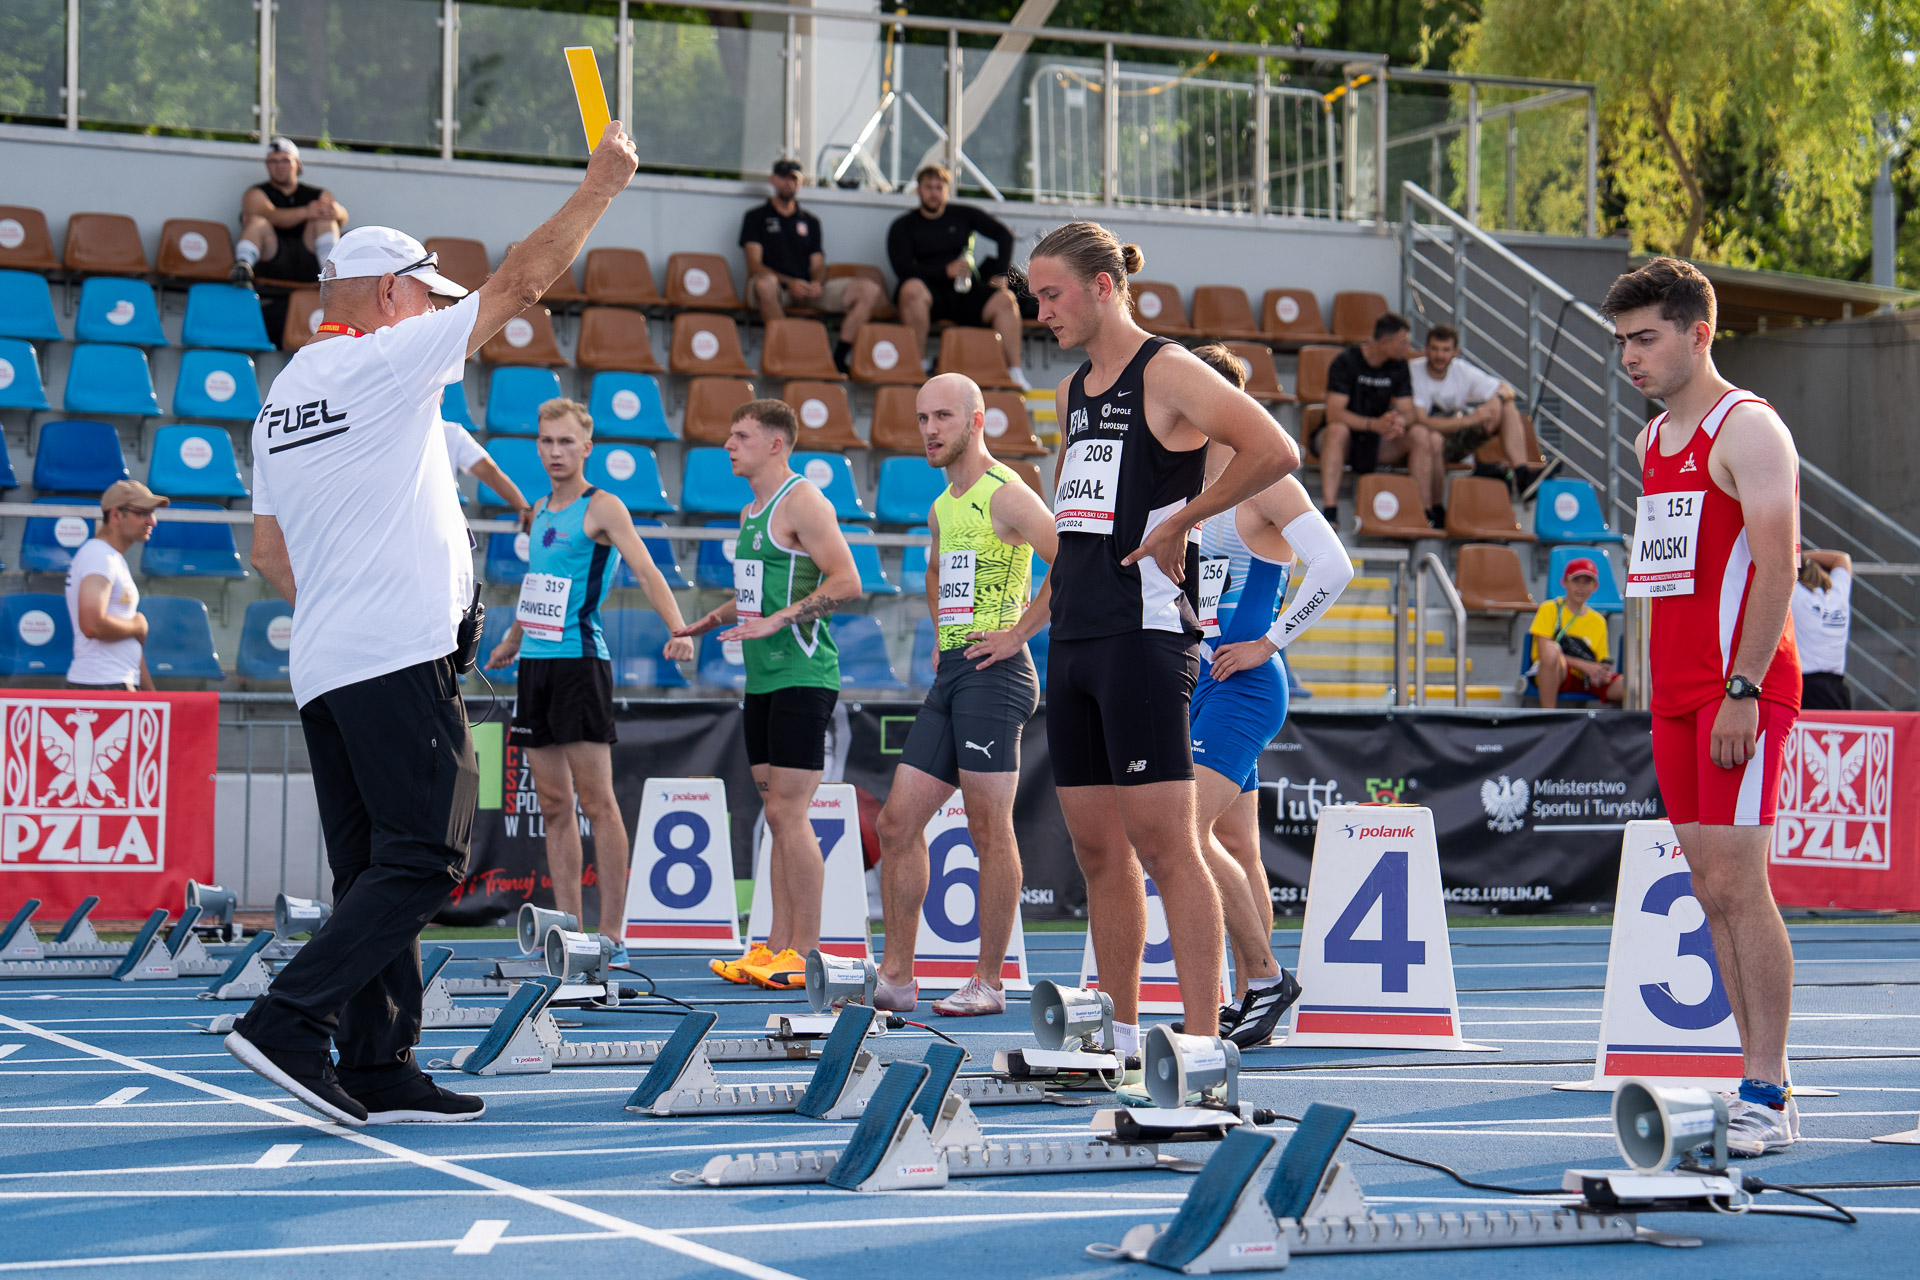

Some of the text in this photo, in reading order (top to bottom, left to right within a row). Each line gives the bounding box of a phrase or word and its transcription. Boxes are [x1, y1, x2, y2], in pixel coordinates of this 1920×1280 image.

[1112, 408, 1132, 416] OPOLE
[1084, 444, 1113, 462] 208
[1667, 497, 1693, 518] 151
[1066, 520, 1083, 528] 2024
[1640, 536, 1688, 562] MOLSKI
[745, 563, 756, 577] 61
[952, 554, 970, 570] 221
[1203, 564, 1223, 580] 256
[545, 579, 566, 594] 319
[938, 582, 970, 600] MBISZ
[1649, 585, 1666, 593] LUBLIN
[519, 600, 563, 618] PAWELEC
[1291, 587, 1330, 624] TERREX
[1191, 746, 1206, 754] rima
[1533, 779, 1628, 796] Ministerstwo
[672, 792, 711, 802] polanik
[1532, 798, 1658, 819] Sportu i Turystyki
[3, 815, 155, 863] PZLA
[1359, 825, 1416, 841] polanik
[1777, 817, 1884, 862] PZLA
[650, 811, 712, 910] 8
[480, 868, 536, 899] Trenuj
[922, 827, 981, 944] 6
[1323, 851, 1425, 993] 4
[1638, 871, 1734, 1030] 3
[908, 1166, 935, 1175] polanik
